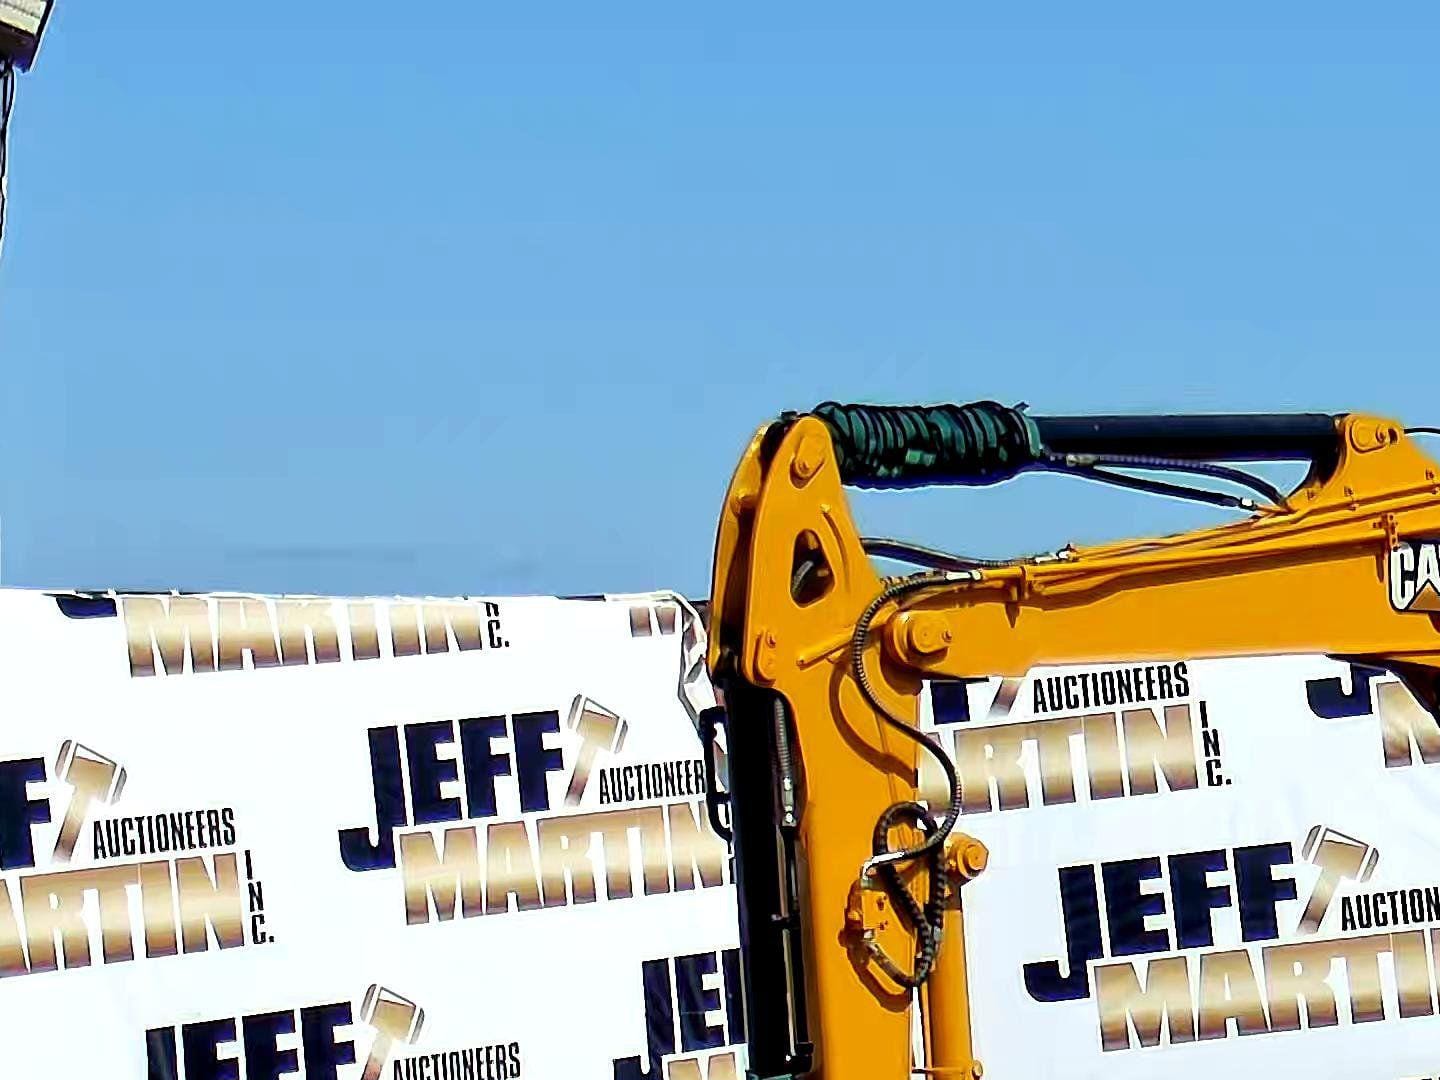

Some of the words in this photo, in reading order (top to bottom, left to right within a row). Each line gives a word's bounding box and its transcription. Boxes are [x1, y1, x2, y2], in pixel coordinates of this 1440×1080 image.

[1033, 661, 1190, 714] AUCTIONEERS
[338, 710, 564, 872] JEFF
[599, 760, 706, 804] AUCTIONEER
[919, 703, 1199, 818] RTIN
[93, 807, 236, 859] AUCTIONEERS
[400, 801, 723, 925] MARTIN
[0, 853, 245, 978] RTIN
[1023, 842, 1297, 1002] JEFF
